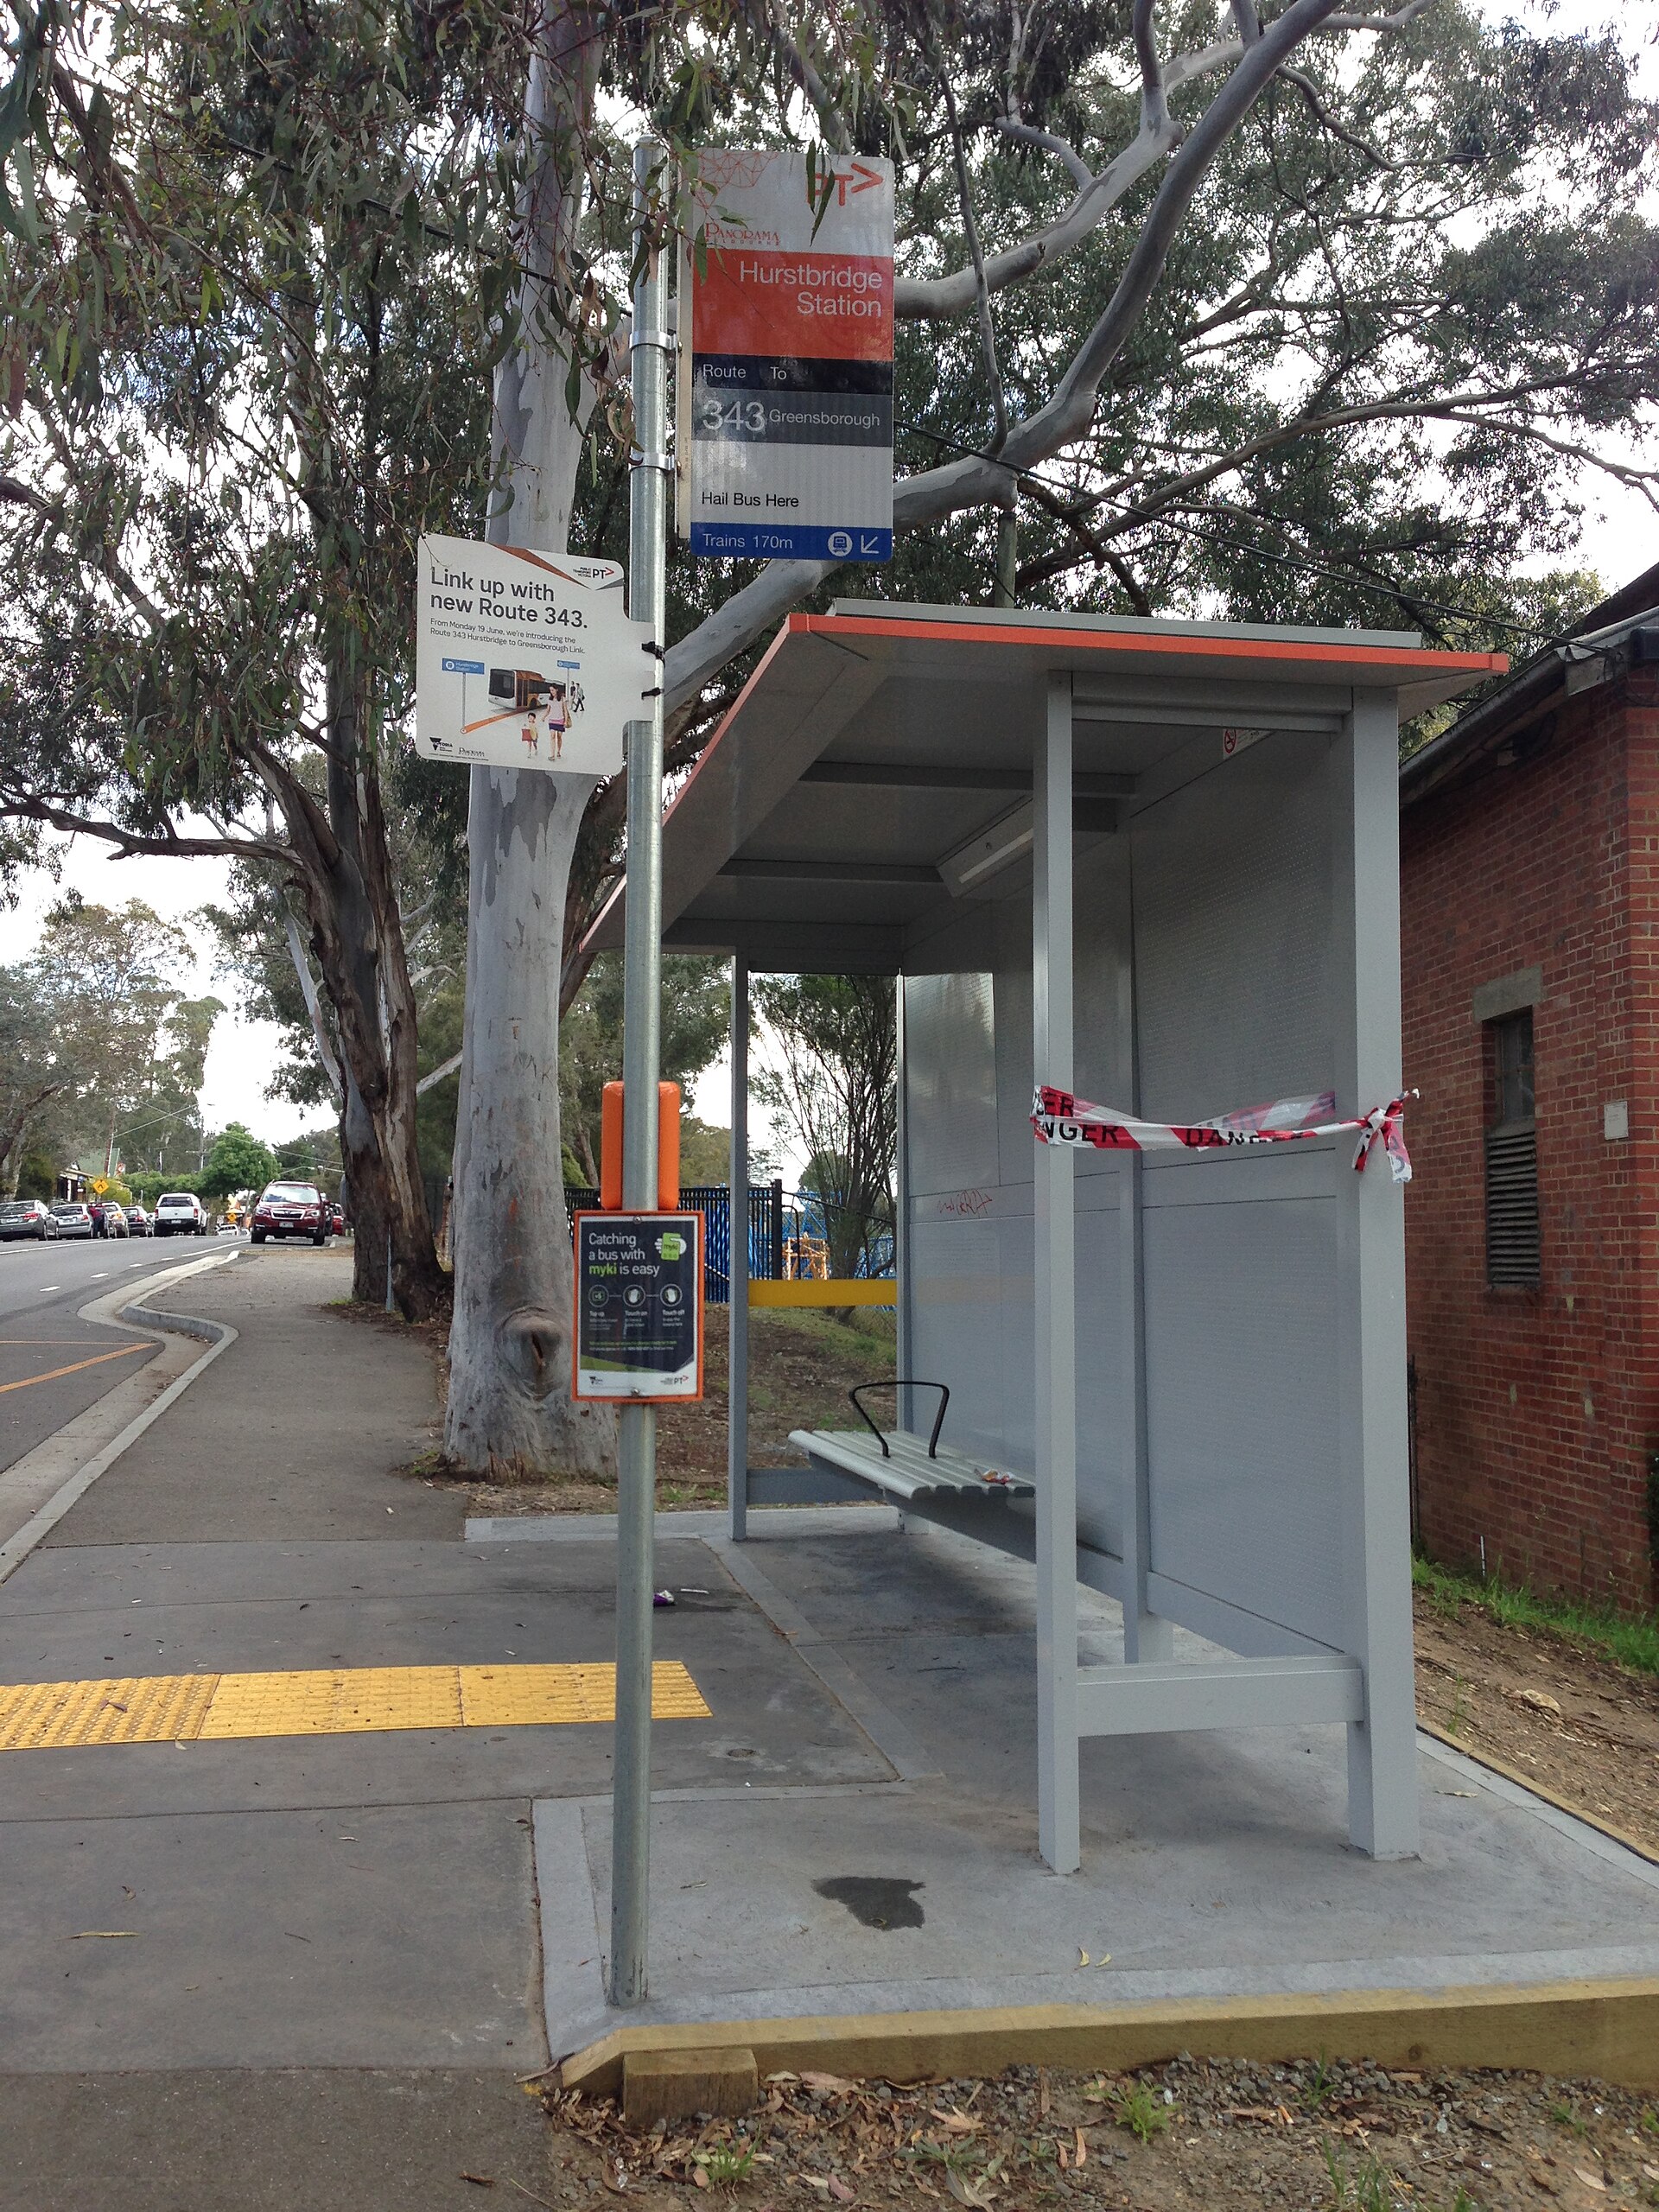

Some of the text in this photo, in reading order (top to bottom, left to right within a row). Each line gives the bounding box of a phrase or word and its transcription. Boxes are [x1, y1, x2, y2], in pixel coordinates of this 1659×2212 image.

[740, 261, 882, 294] Hurstbridge
[797, 291, 881, 317] Station
[702, 364, 787, 380] Route To
[702, 399, 880, 432] 343 Greensborough
[702, 492, 799, 508] Hail Bus Here
[702, 533, 793, 550] Trains 170m
[431, 566, 555, 601] Link up with
[431, 594, 588, 629] new Route 343.
[430, 618, 448, 627] From
[449, 620, 476, 632] Monday
[486, 626, 505, 636] June,
[525, 632, 563, 644] introducing
[430, 627, 586, 654] Route 343 Hurstbridge to Greensborough Link.
[588, 1232, 637, 1249] Catching
[664, 1243, 680, 1251] myki
[588, 1248, 645, 1261] a bus with
[588, 1262, 660, 1278] myki is easy
